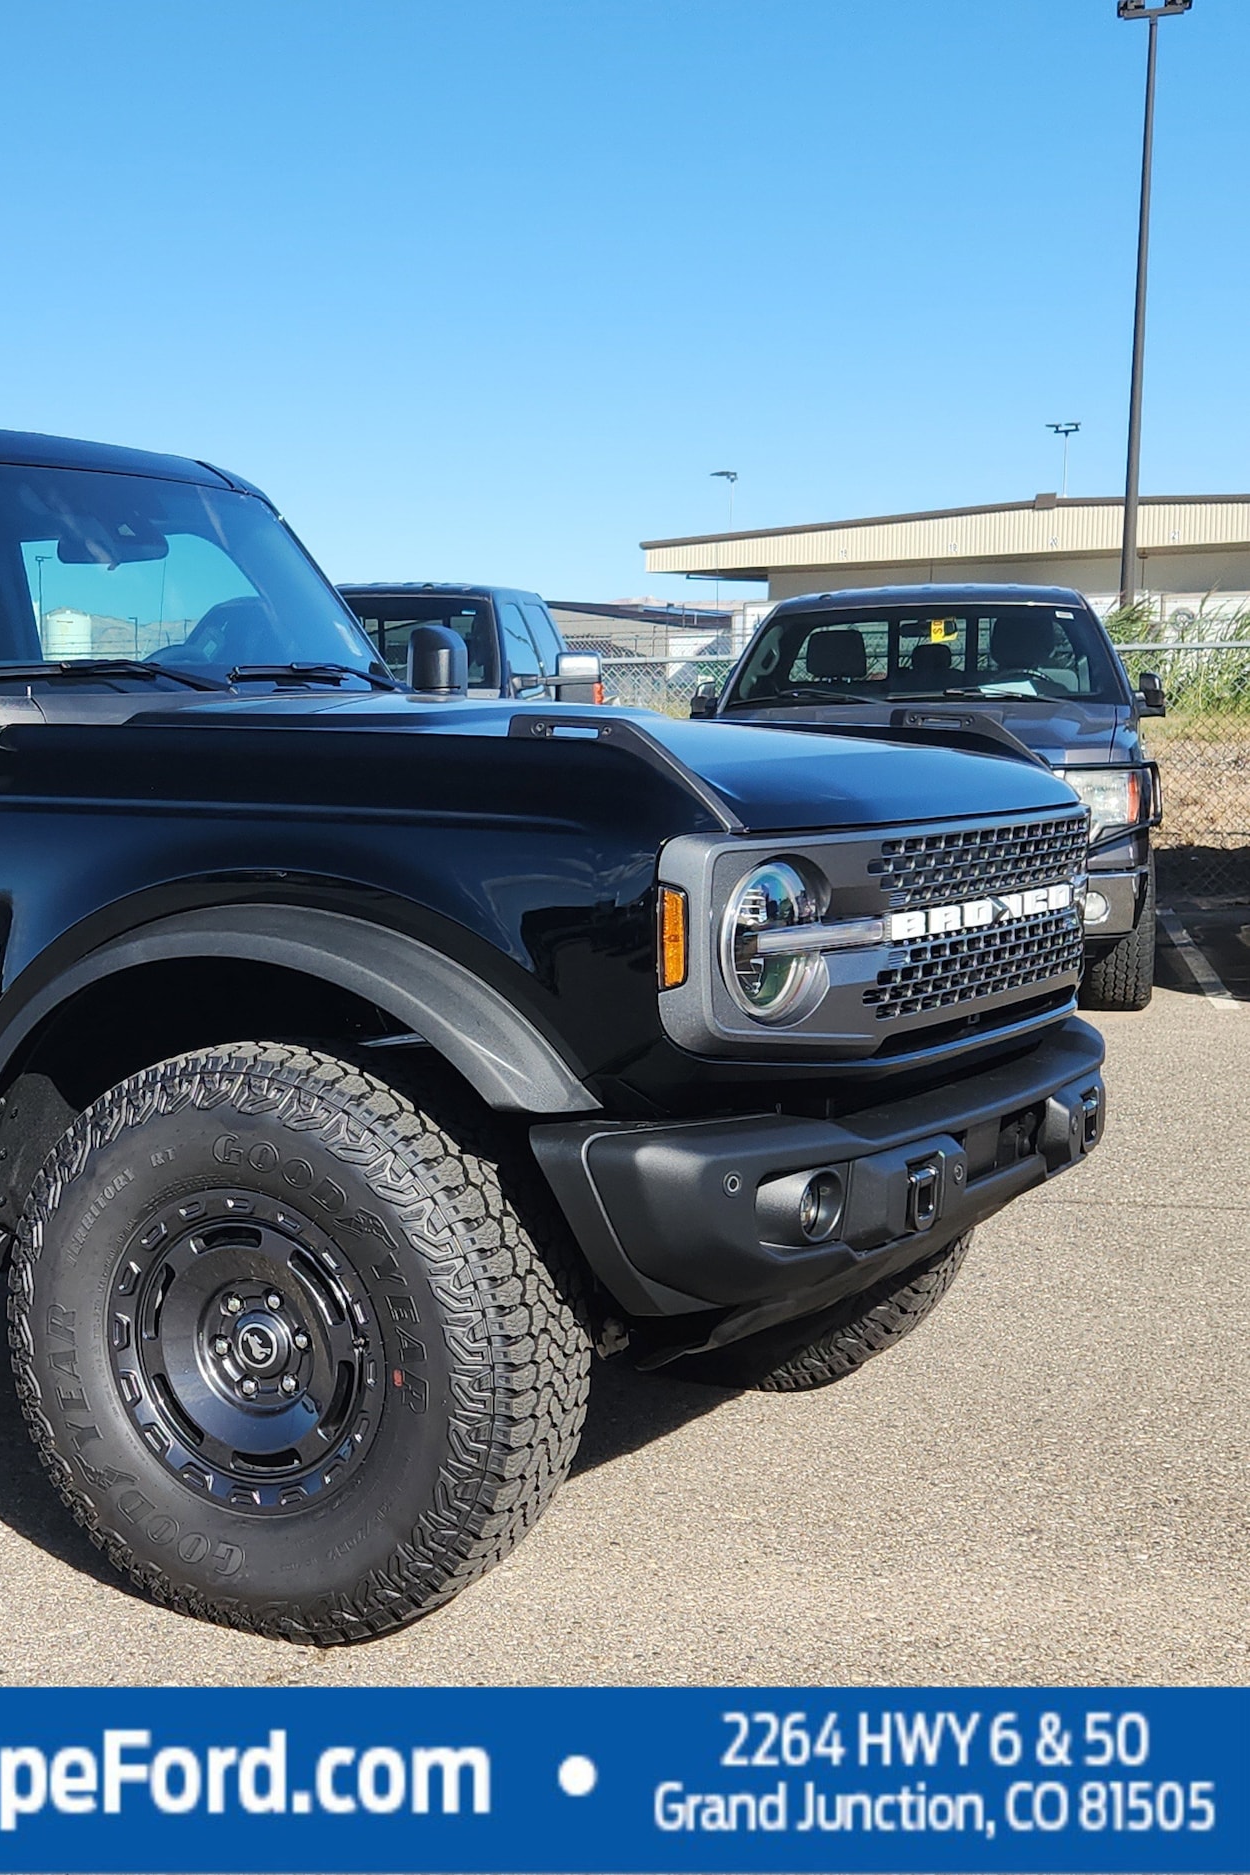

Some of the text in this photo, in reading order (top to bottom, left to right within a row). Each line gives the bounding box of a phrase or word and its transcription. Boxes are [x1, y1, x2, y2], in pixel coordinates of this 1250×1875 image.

[891, 884, 1071, 941] BRONCO
[66, 1146, 177, 1268] TERRITORY RT
[211, 1132, 431, 1415] GOODYEAR
[46, 1302, 247, 1578] GOODYEAR
